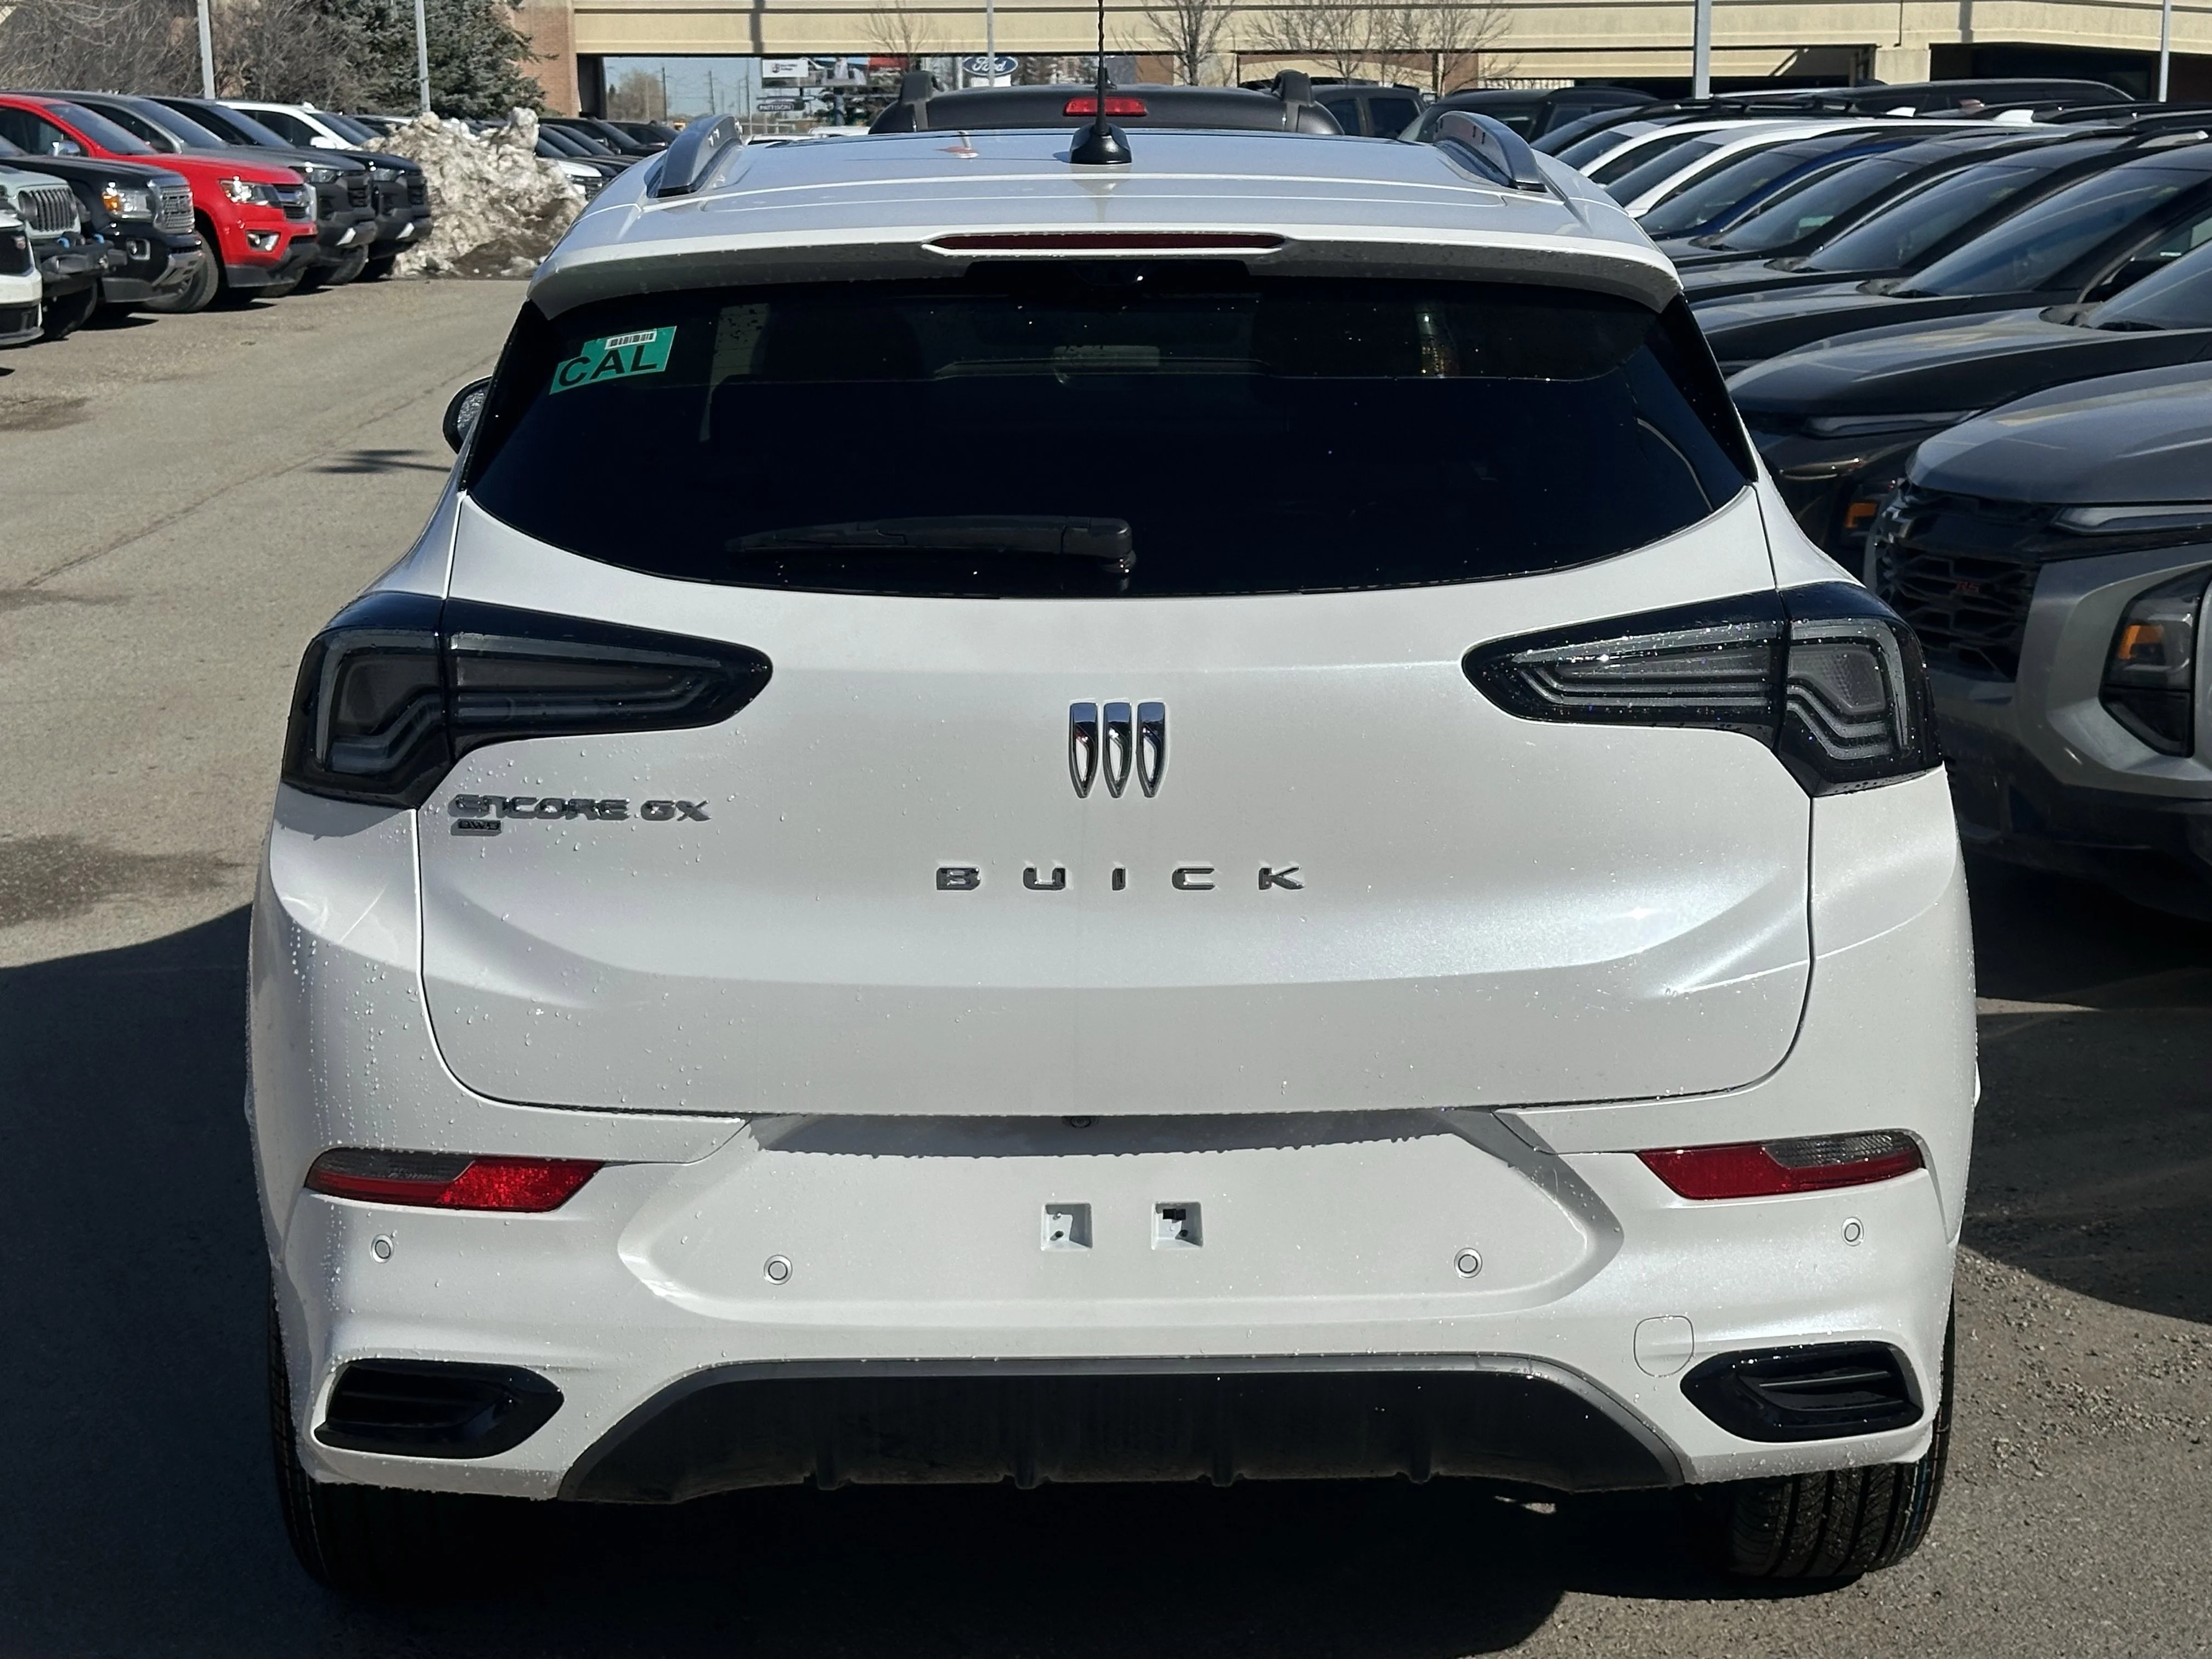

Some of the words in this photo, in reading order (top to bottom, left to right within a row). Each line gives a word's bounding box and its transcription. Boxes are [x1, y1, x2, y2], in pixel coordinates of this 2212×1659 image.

[972, 57, 1007, 71] Fod
[558, 345, 658, 387] CAL
[1956, 582, 1979, 592] RS
[641, 799, 712, 822] GX
[936, 867, 1306, 891] BUICK
